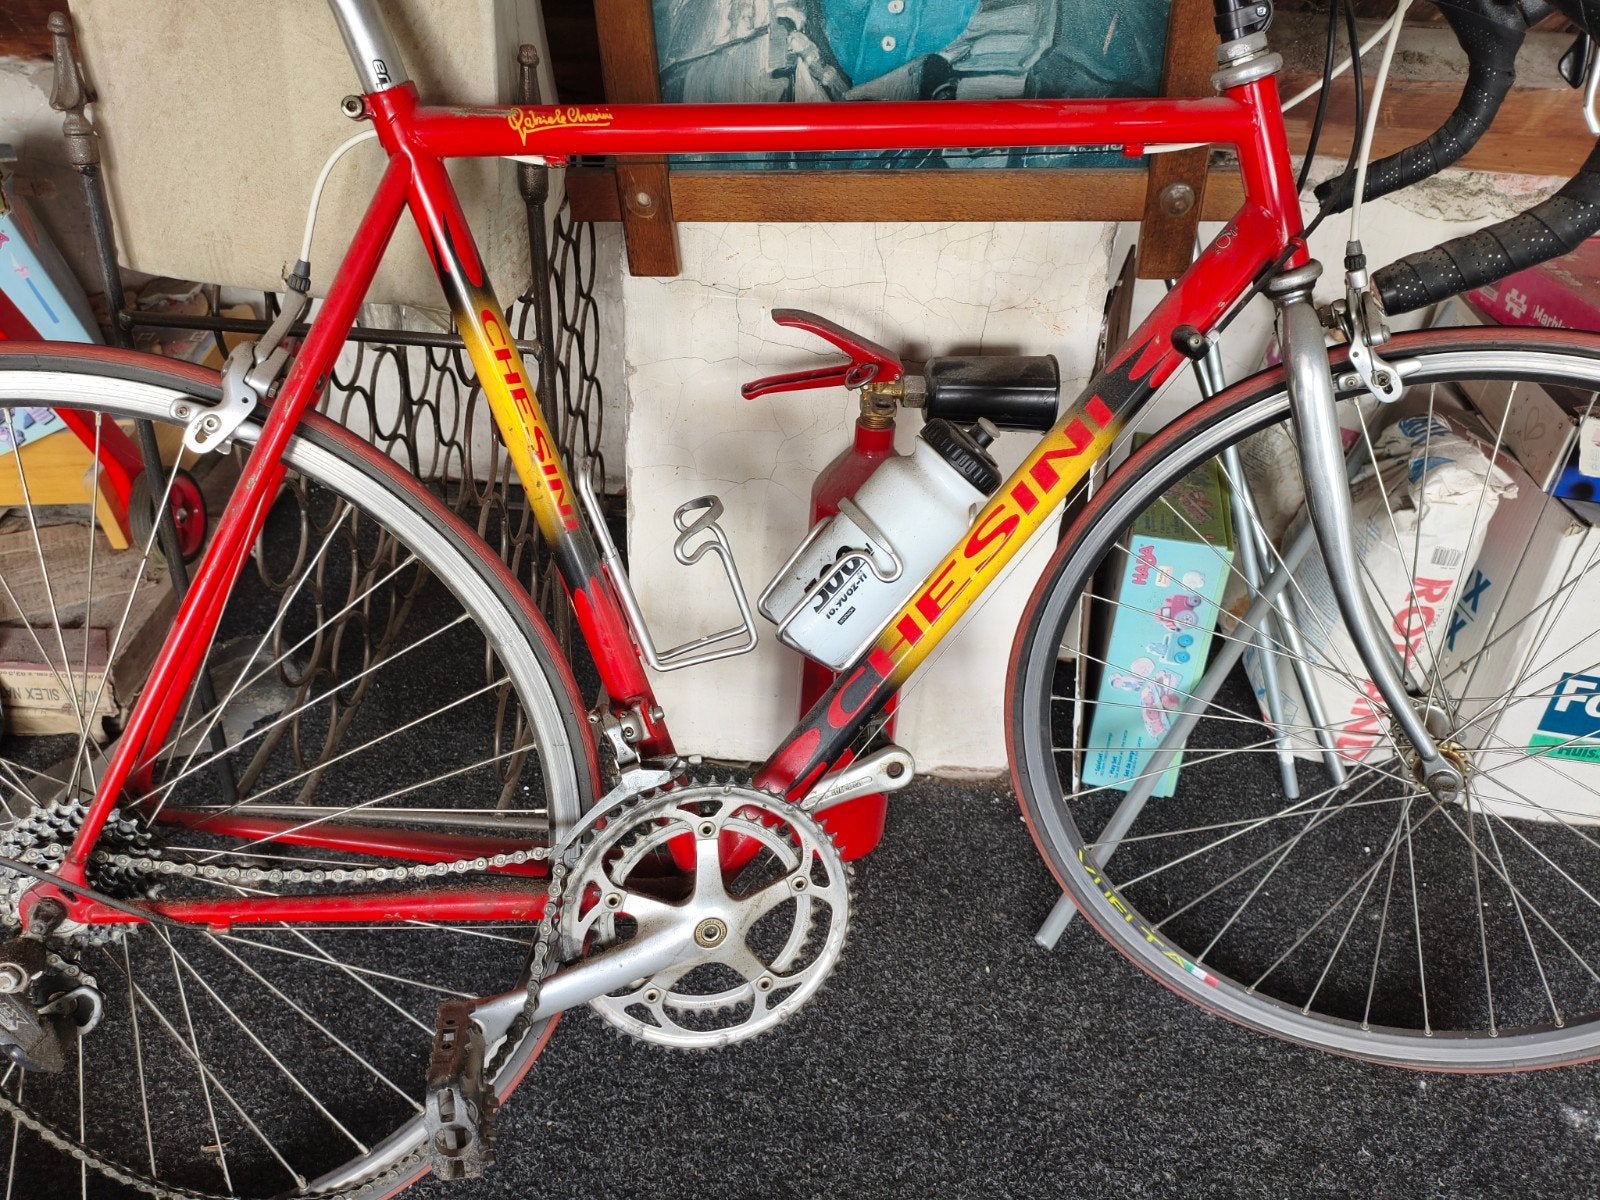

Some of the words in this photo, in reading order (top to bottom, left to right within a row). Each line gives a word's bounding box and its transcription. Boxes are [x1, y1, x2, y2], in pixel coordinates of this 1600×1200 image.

[480, 309, 580, 532] CHESINI
[827, 394, 1115, 728] CHESINI
[1131, 545, 1157, 585] HABA
[26, 686, 60, 701] SILEX
